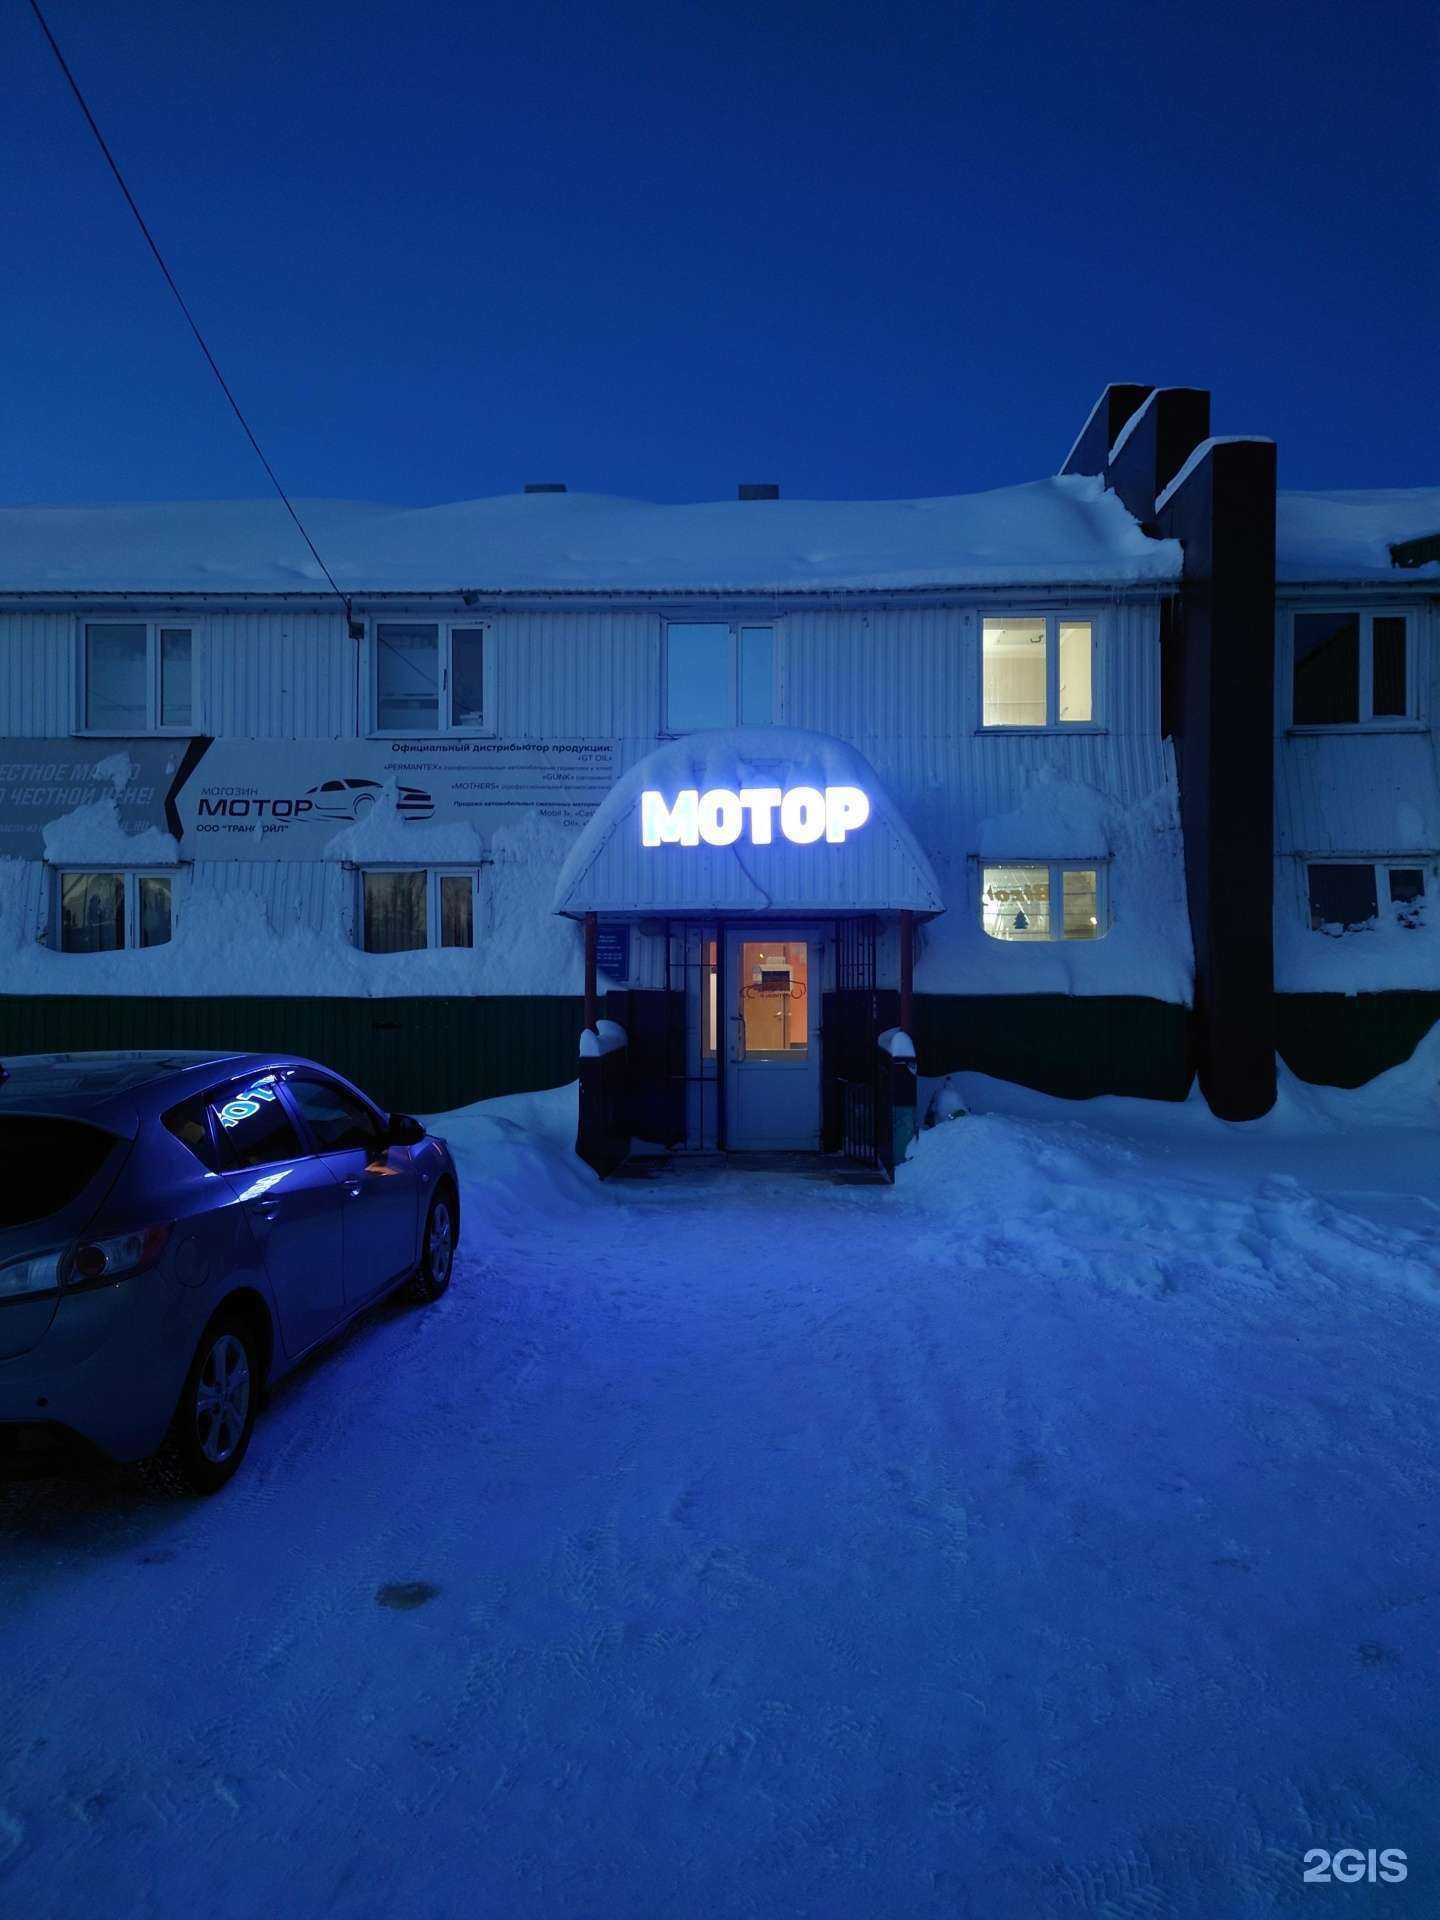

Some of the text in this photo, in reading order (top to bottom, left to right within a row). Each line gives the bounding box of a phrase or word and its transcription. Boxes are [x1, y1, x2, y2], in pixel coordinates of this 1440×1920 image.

[391, 743, 470, 753] Официальный
[472, 744, 549, 754] дистрибьютор
[0, 763, 68, 781] ЕСТНОЕ
[198, 798, 313, 817] МОТОР
[641, 786, 870, 847] МОТОР
[196, 824, 220, 833] ООО
